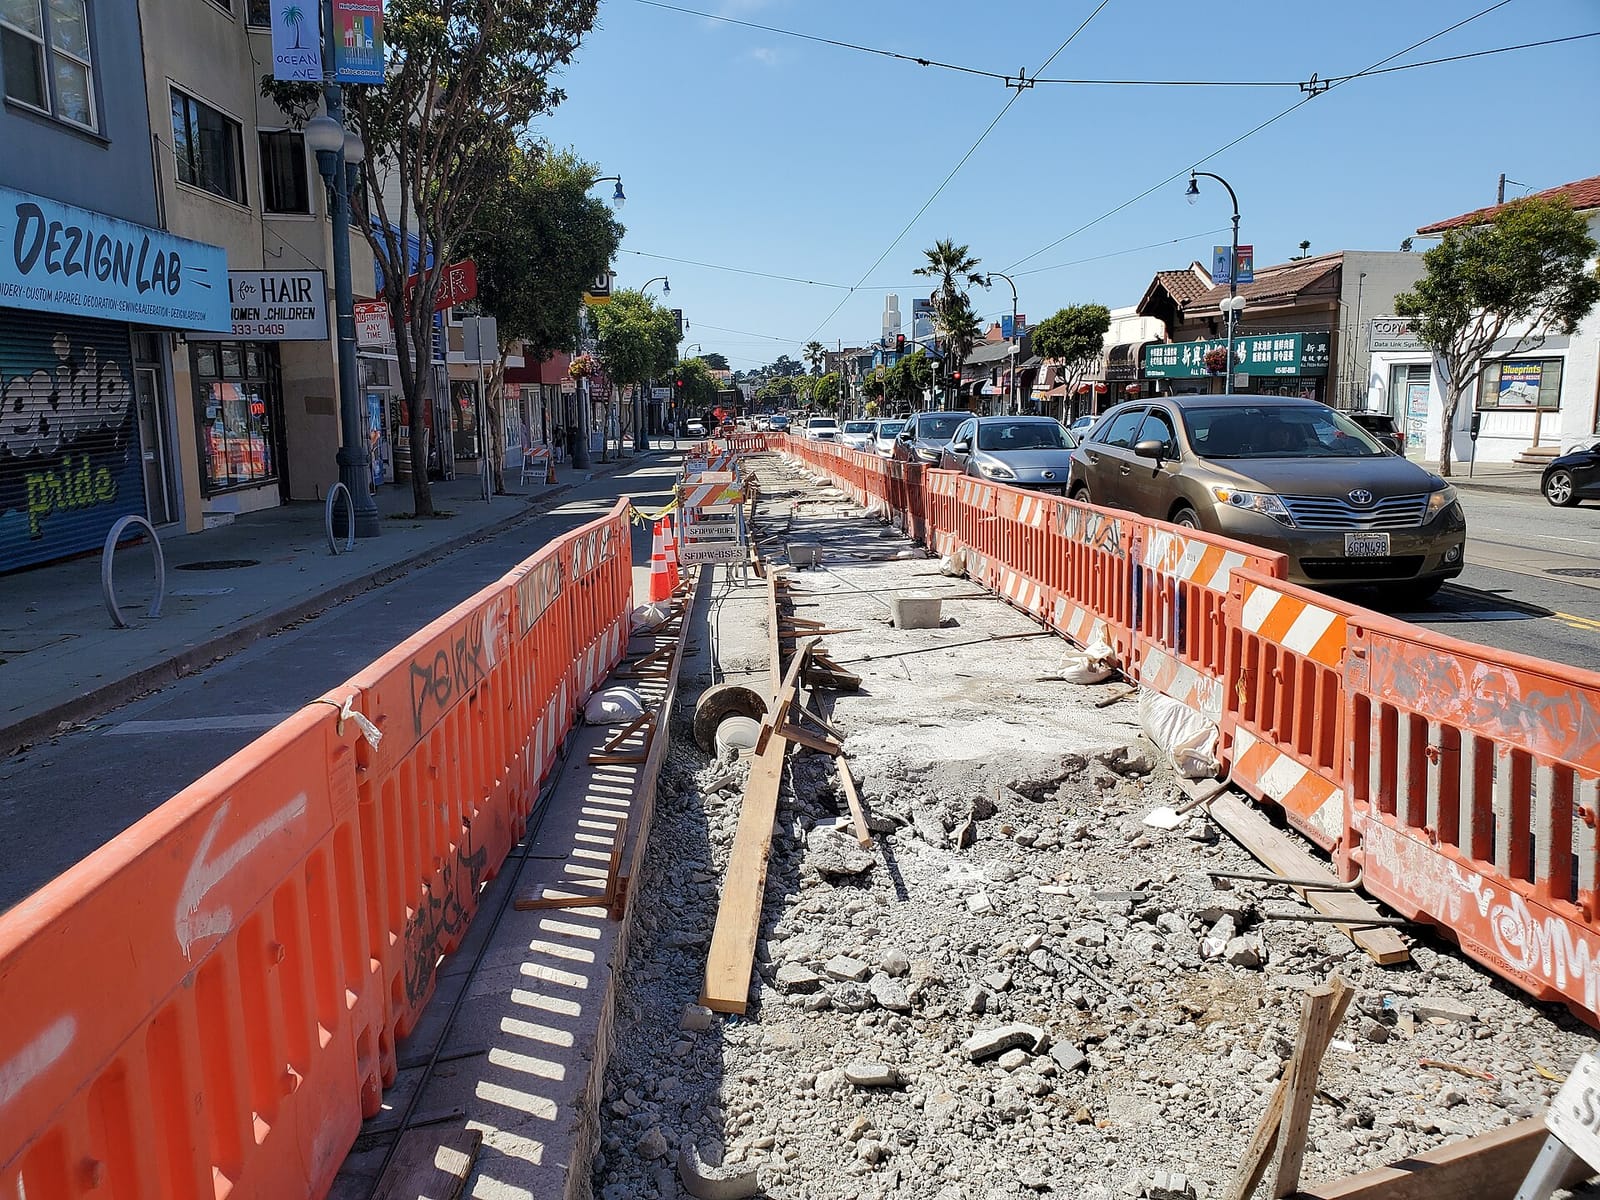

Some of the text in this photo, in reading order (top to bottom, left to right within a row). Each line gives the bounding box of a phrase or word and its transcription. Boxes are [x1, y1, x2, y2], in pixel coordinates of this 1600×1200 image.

[339, 3, 379, 12] Neighborhood
[277, 53, 318, 65] OCEAN
[292, 69, 318, 79] AVE
[14, 202, 181, 296] DEZIGN LAB
[237, 280, 256, 300] for
[260, 278, 312, 302] HAIR
[55, 290, 81, 306] APPAREL
[355, 312, 387, 322] NO STOPPING
[366, 323, 381, 331] ANY
[367, 331, 382, 339] TIME
[1503, 365, 1541, 374] Blueprints
[25, 454, 117, 540] pride
